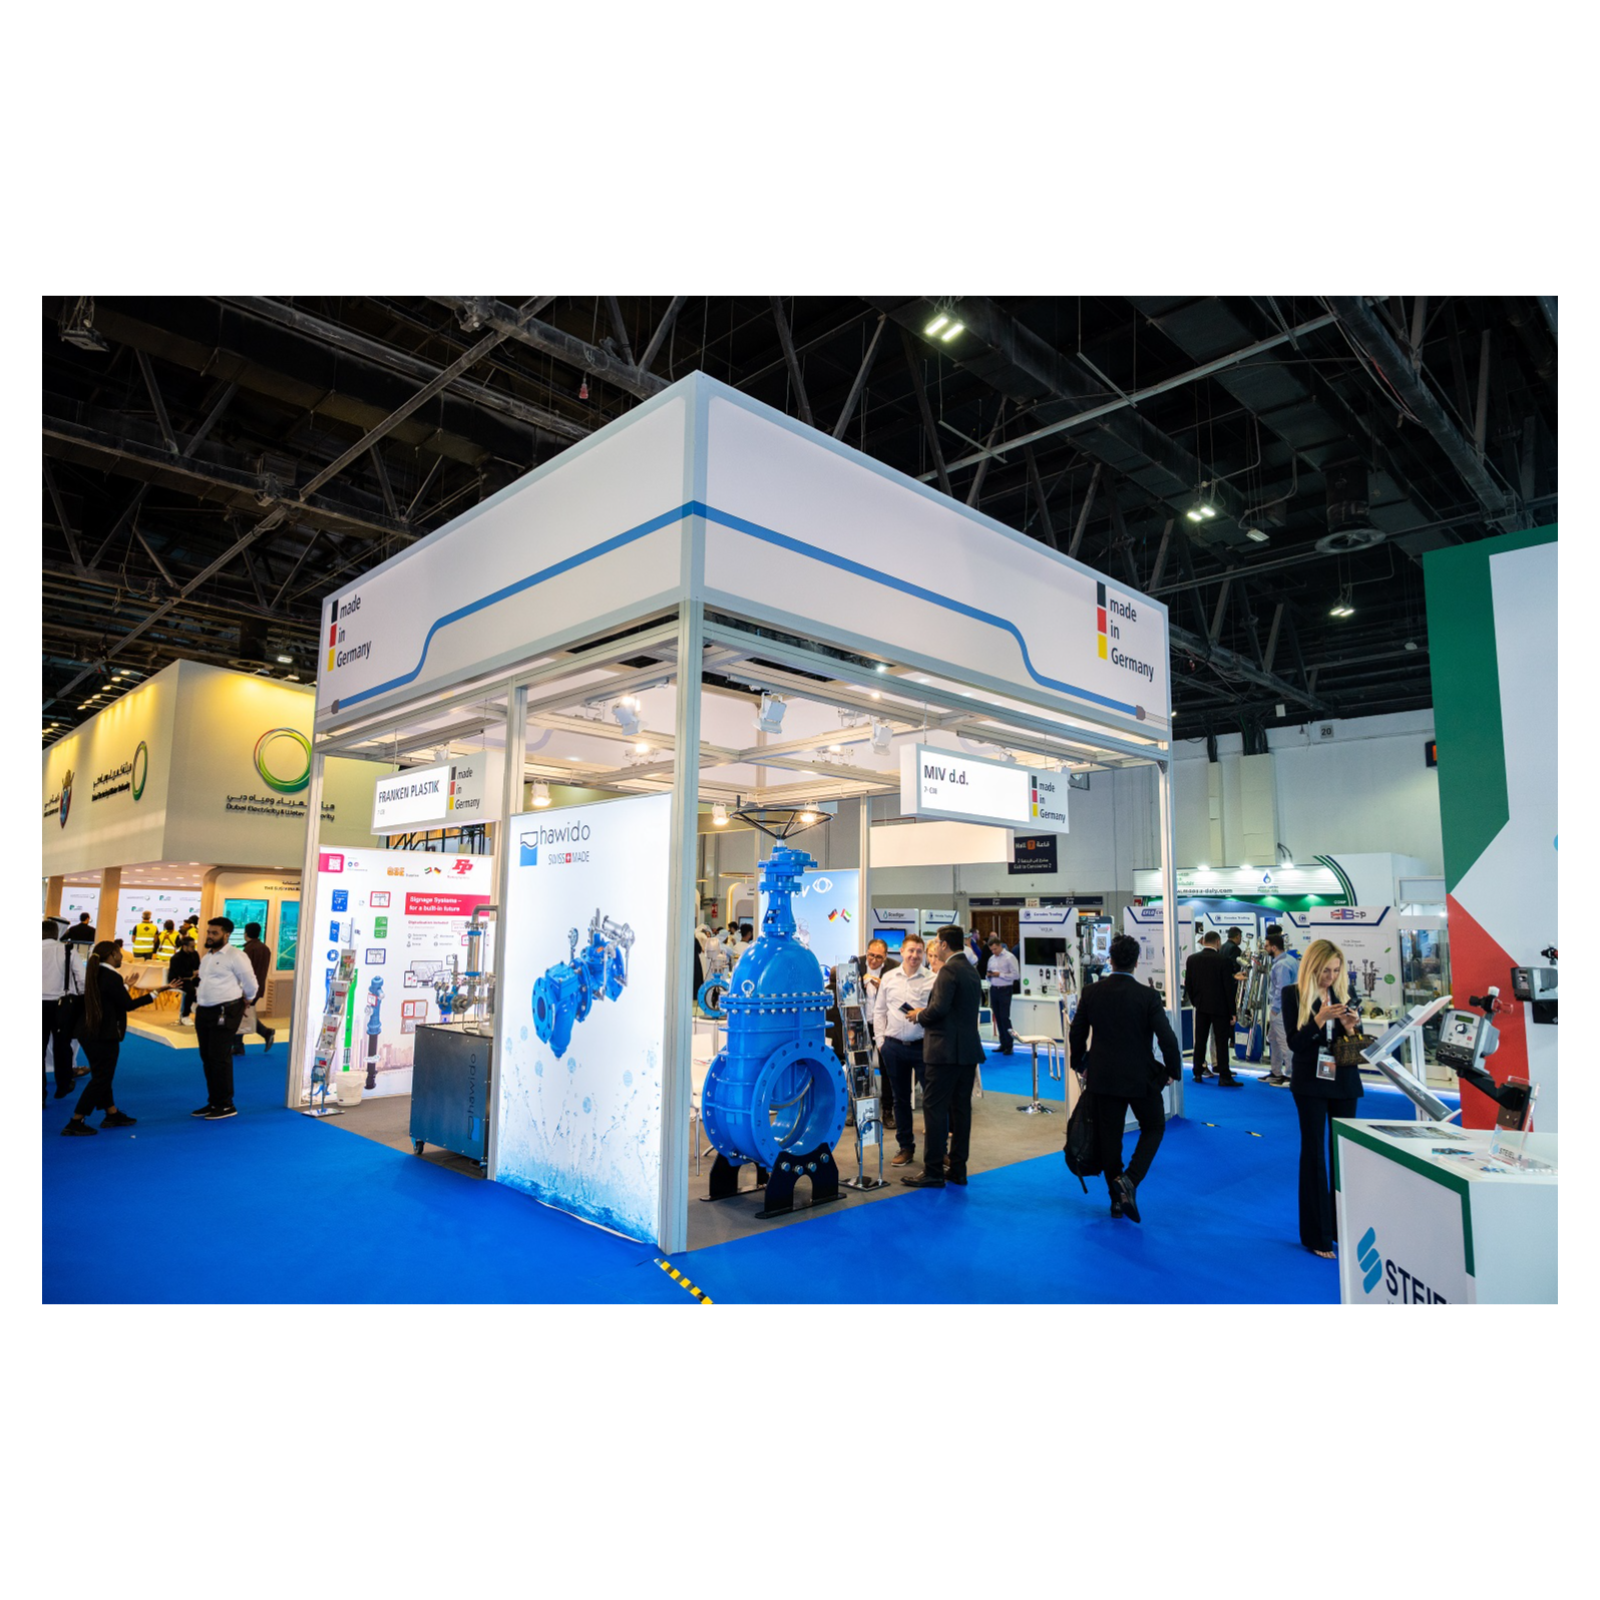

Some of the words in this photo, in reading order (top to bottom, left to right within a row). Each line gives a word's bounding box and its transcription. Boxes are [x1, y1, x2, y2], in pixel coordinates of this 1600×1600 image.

[340, 594, 361, 618] made
[1110, 598, 1136, 622] made
[338, 627, 345, 643] in
[1110, 620, 1120, 639] in
[337, 640, 372, 667] Germany
[1111, 648, 1154, 682] Germany
[457, 767, 473, 780] made
[924, 765, 946, 781] MIV
[949, 769, 969, 785] d.d.
[379, 786, 409, 803] FRANKEN
[411, 780, 440, 796] PLASTIK
[456, 785, 462, 795] in
[1039, 781, 1055, 792] made
[455, 798, 480, 809] Germany
[1040, 794, 1045, 804] in
[1040, 809, 1066, 823] Germany
[540, 820, 590, 845] hawido
[548, 853, 566, 865] SWISS
[572, 851, 589, 862] MADE
[467, 1053, 476, 1114] hawido
